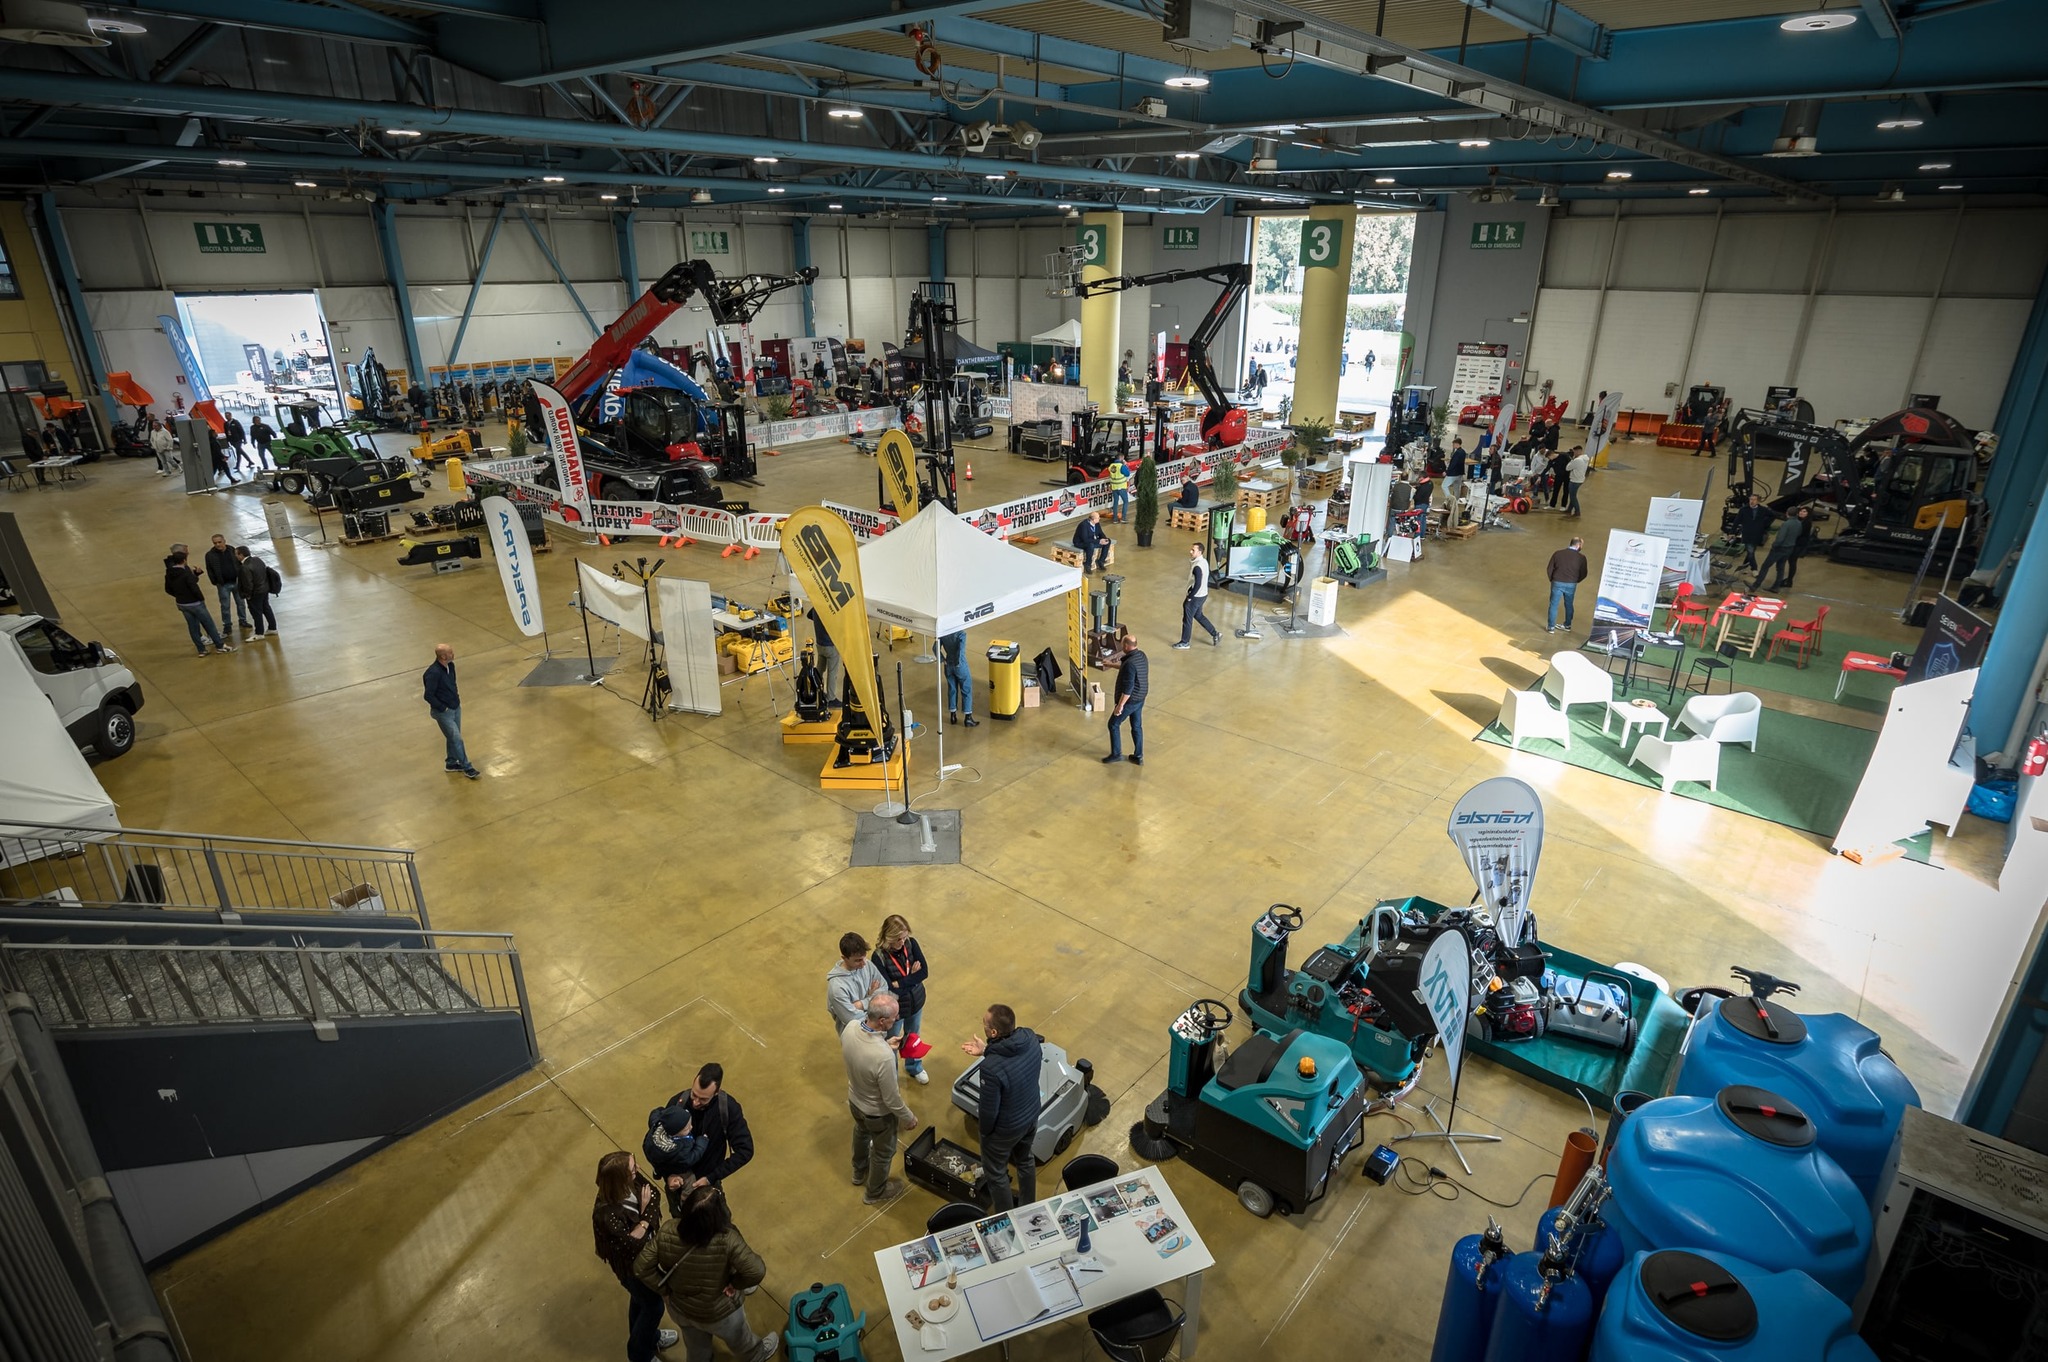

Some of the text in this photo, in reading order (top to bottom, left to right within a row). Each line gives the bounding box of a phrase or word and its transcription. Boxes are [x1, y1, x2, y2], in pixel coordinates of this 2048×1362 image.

[1084, 229, 1099, 260] 3
[1309, 225, 1331, 261] 3
[611, 301, 649, 342] MANITOU
[1777, 430, 1809, 441] HYUNDAI
[1002, 496, 1054, 519] OPERATORS
[1012, 510, 1047, 529] TROPHY
[964, 601, 994, 622] MB
